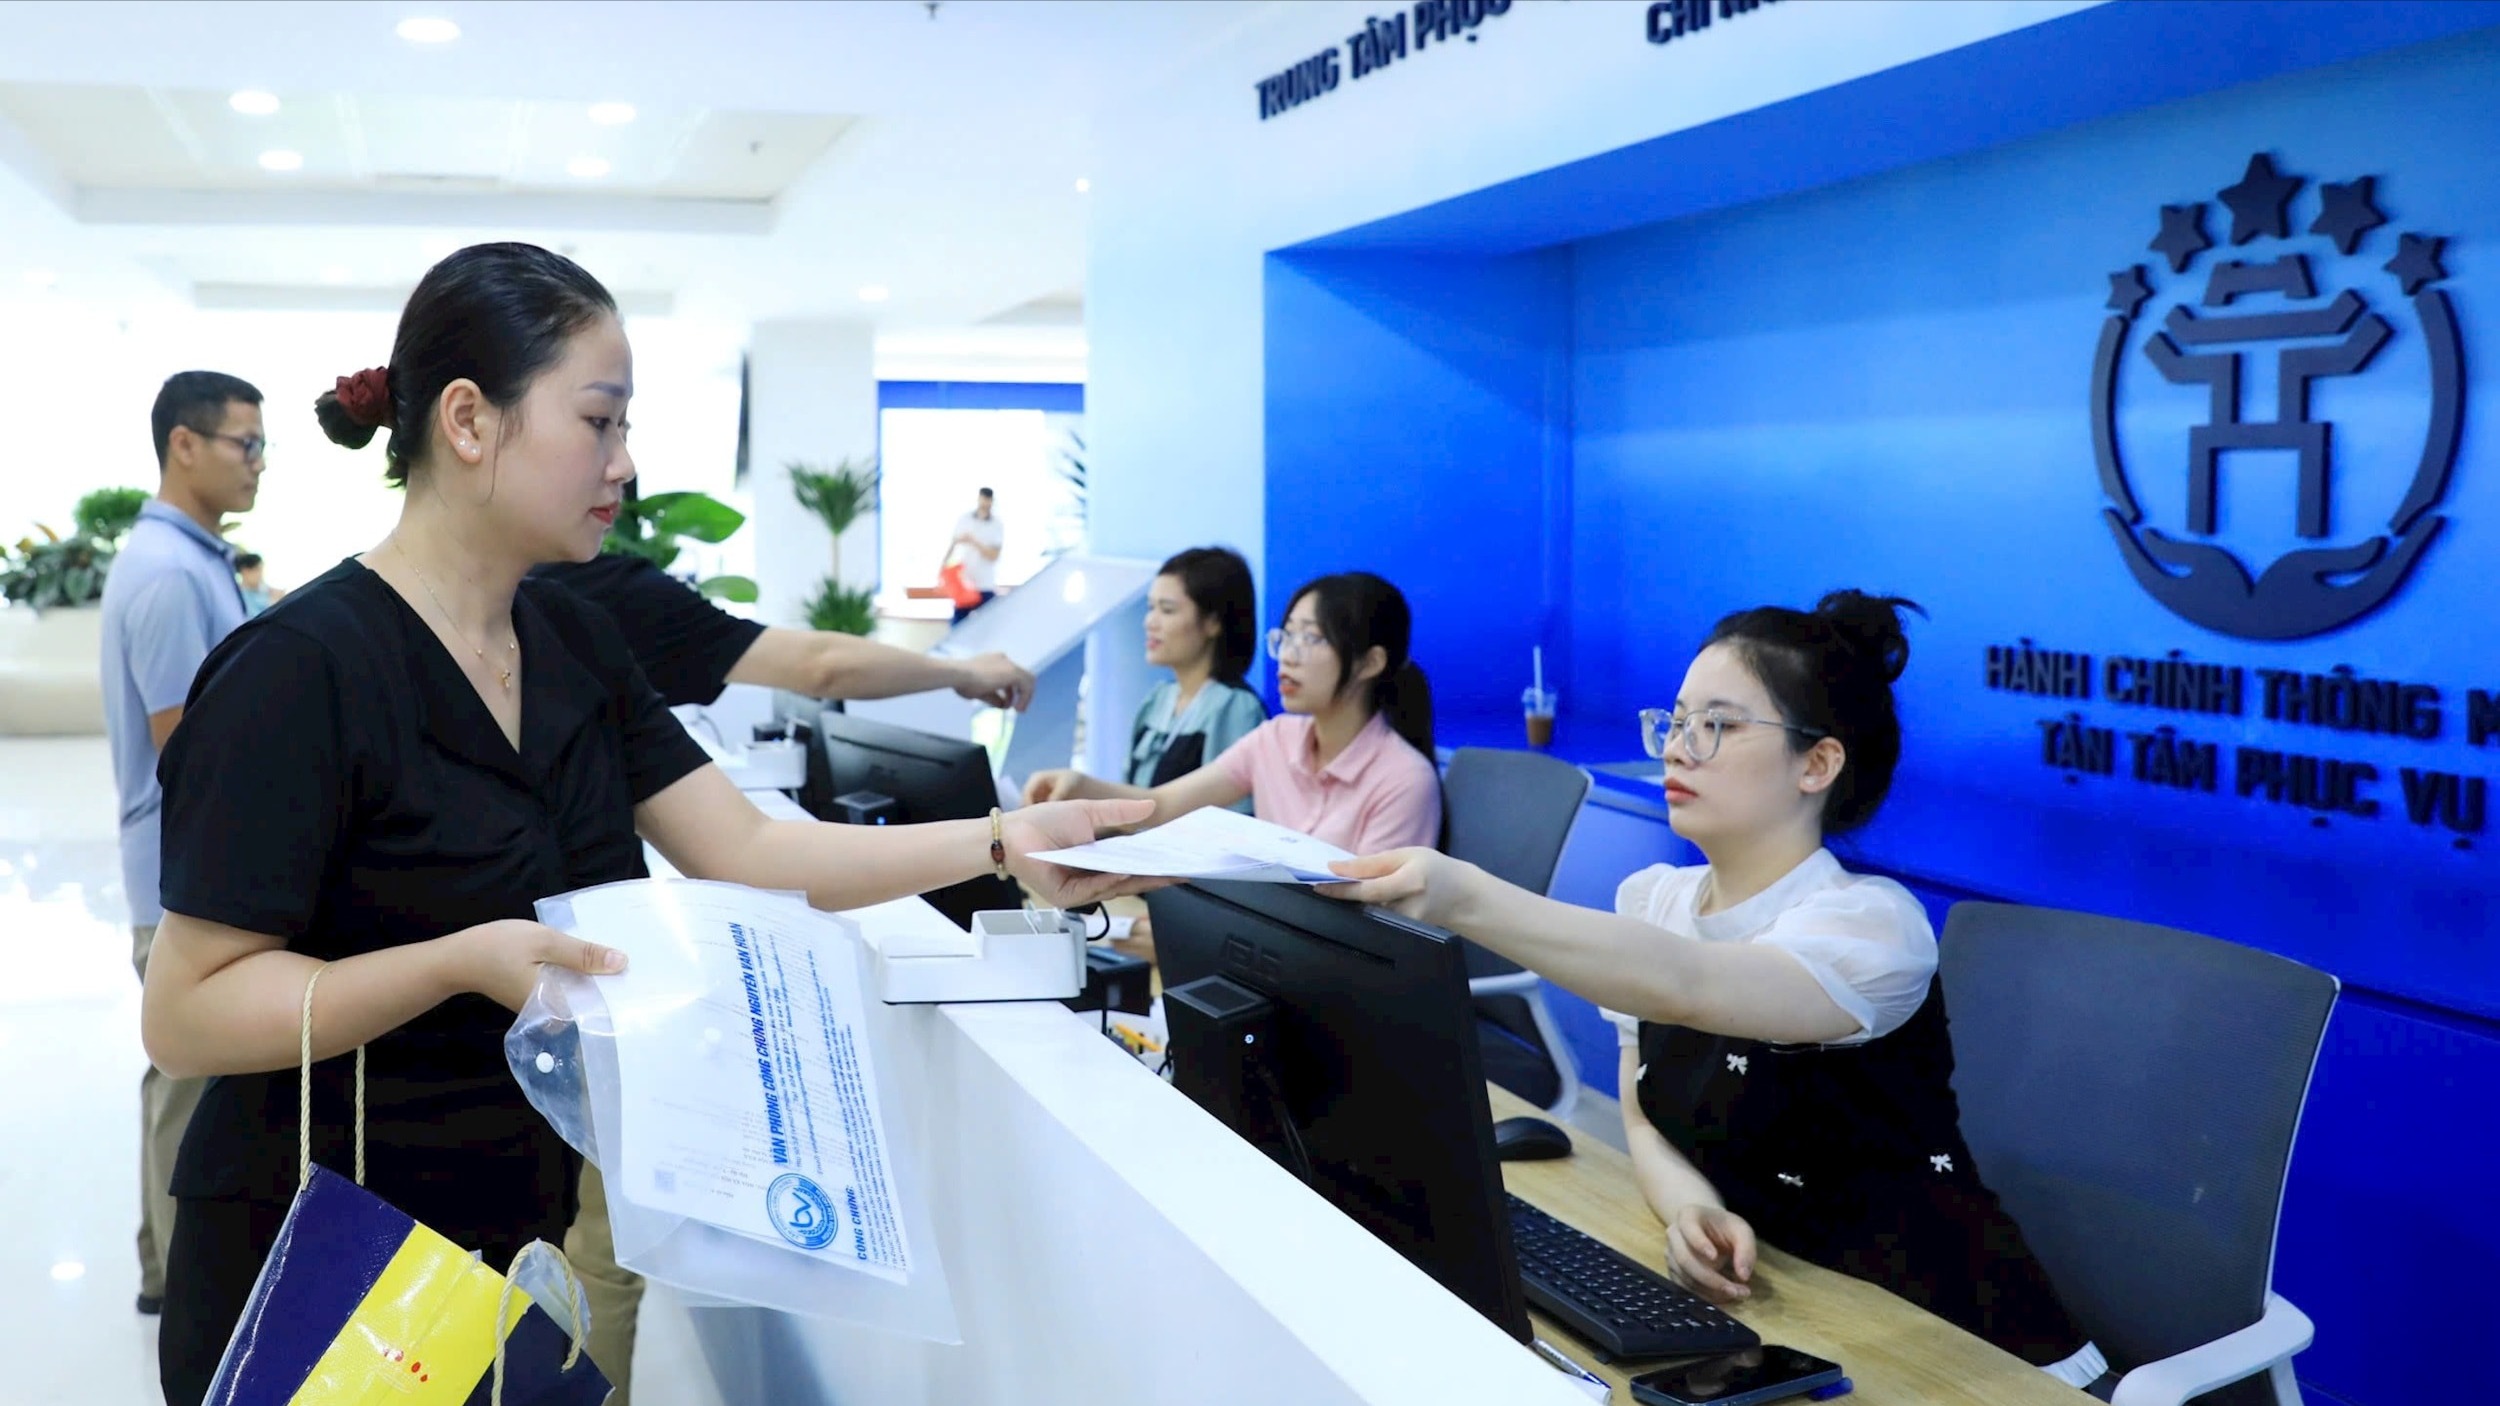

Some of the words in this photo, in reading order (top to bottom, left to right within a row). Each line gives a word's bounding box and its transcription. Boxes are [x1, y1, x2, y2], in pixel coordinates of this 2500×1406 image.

[1255, 47, 1340, 120] TRUNG
[1346, 16, 1406, 79] TÂM
[1986, 637, 2092, 700] HÀNH
[2104, 649, 2244, 717] CHÍNH
[2255, 664, 2441, 741] THÔNG
[2036, 711, 2116, 786] TẬN
[2126, 725, 2218, 793] TÂM
[2235, 746, 2380, 829] PHỤC
[2399, 768, 2487, 849] VỤ
[758, 1058, 776, 1092] CÔNG
[764, 1092, 784, 1136] PHÒNG
[770, 1137, 788, 1164] VĂN
[854, 1228, 868, 1261] CÔNG
